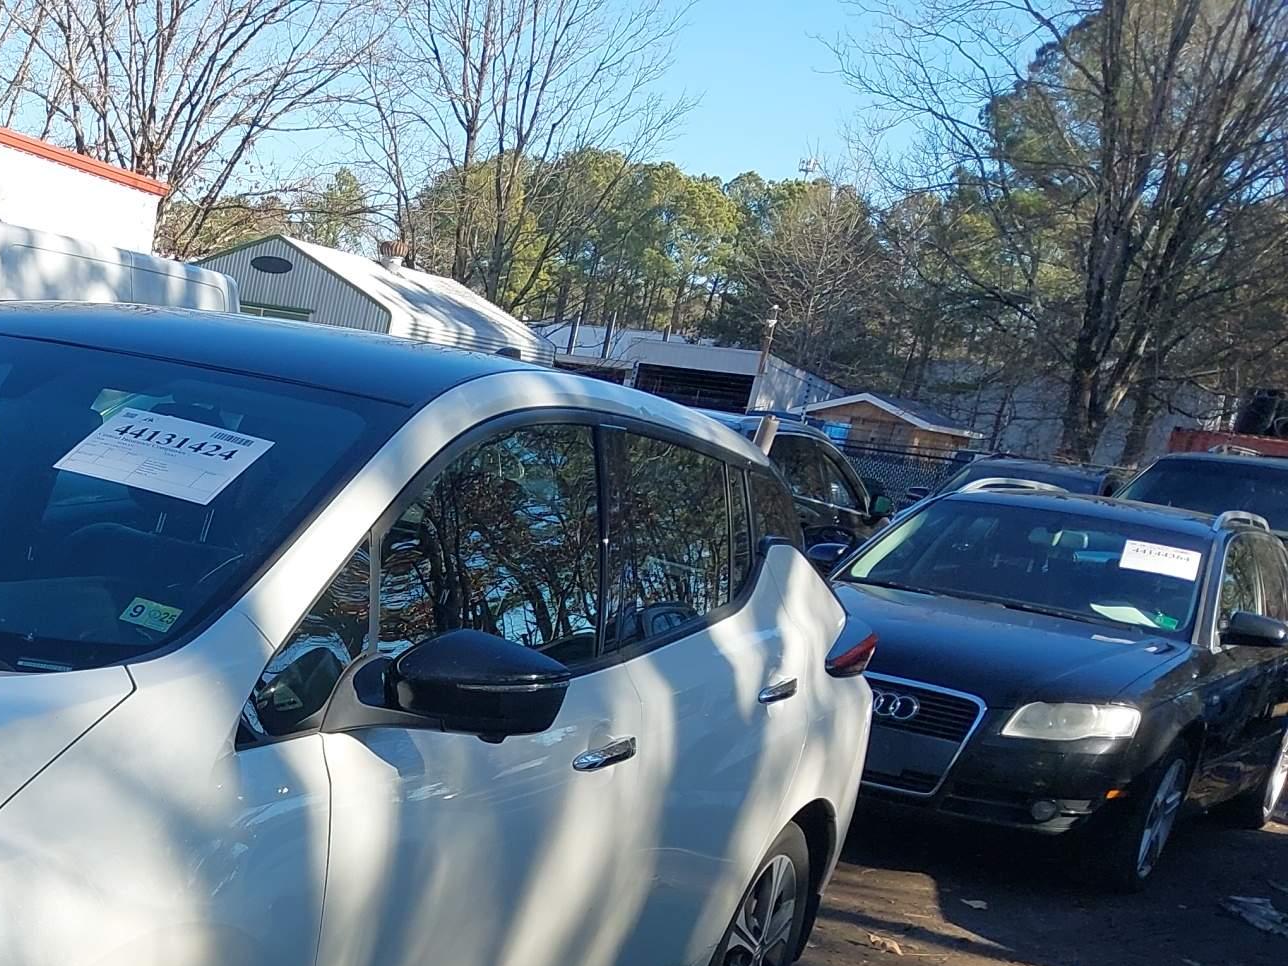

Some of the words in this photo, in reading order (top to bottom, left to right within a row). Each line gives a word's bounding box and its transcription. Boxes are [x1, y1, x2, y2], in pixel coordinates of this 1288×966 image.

[114, 424, 239, 461] 44131424
[130, 605, 145, 617] 9
[159, 612, 177, 625] 25
